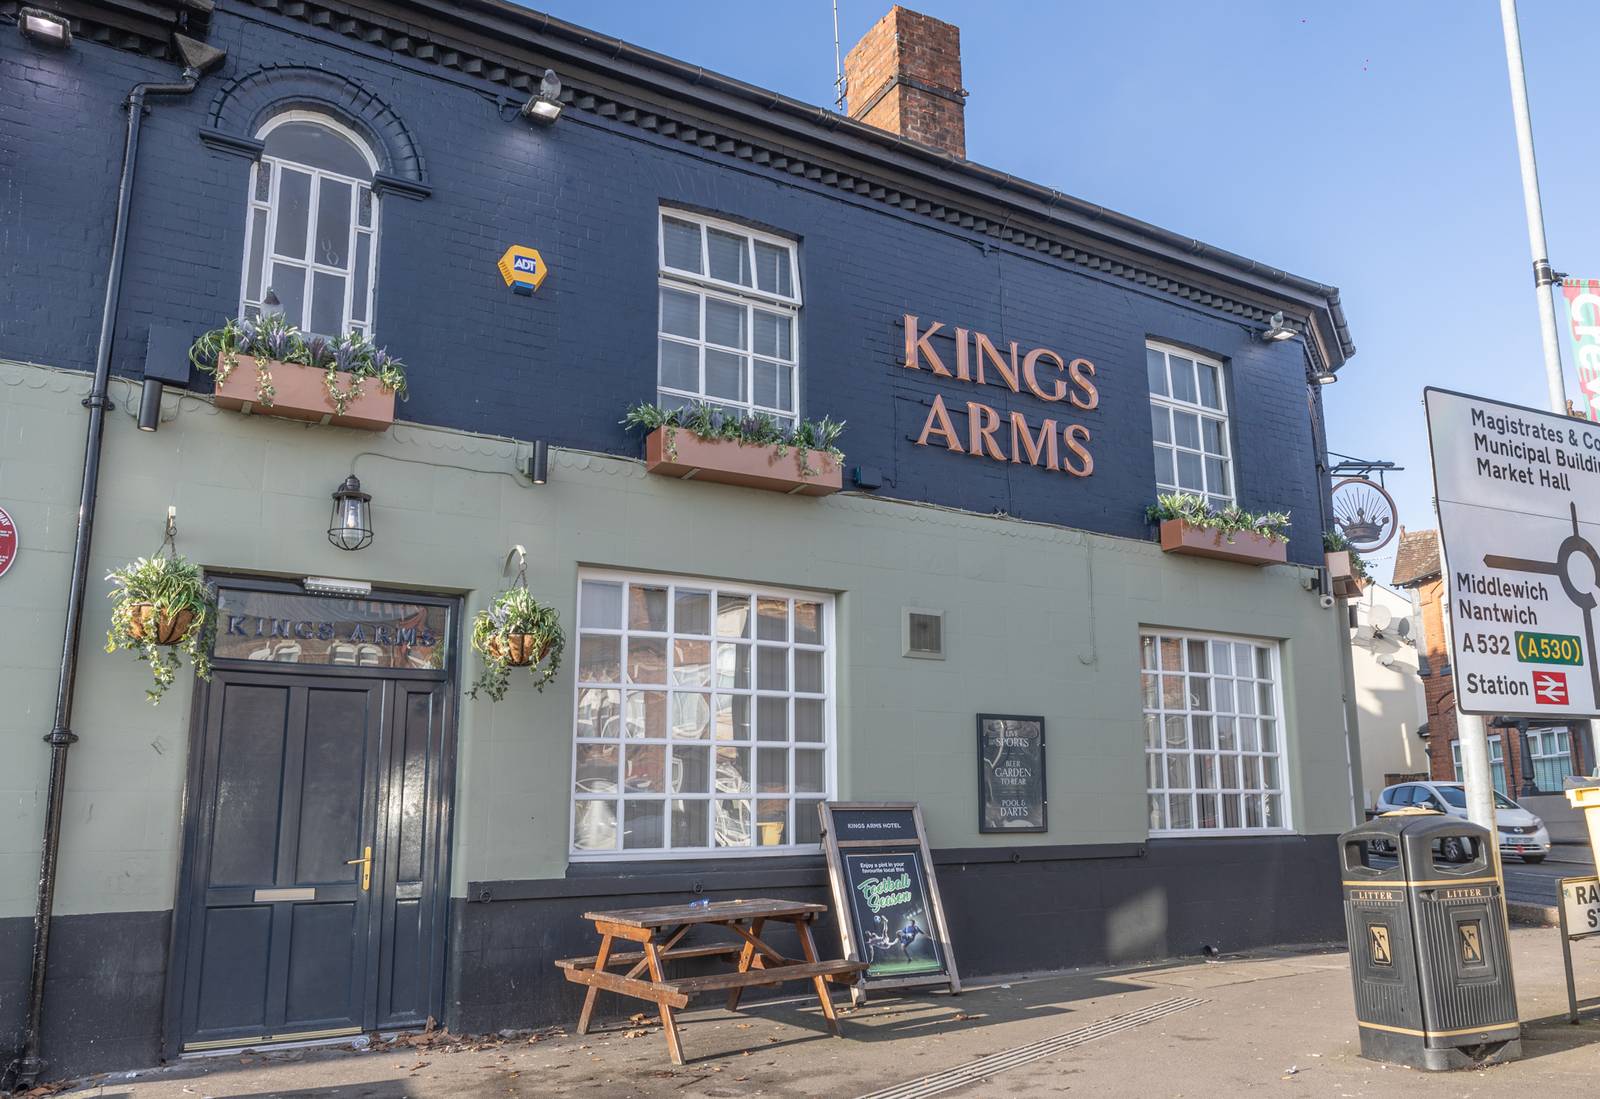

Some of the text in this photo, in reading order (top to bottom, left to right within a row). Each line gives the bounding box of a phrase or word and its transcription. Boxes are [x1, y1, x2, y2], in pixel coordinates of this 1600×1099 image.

[514, 258, 536, 272] ADT
[903, 313, 1099, 410] KINGS
[915, 393, 1094, 478] ARMS
[1471, 407, 1563, 443] Magistrates
[1568, 429, 1578, 447] &
[1474, 432, 1551, 465] Municipal
[1477, 457, 1571, 491] Market Hall
[1457, 572, 1548, 601] Middlewich
[1459, 599, 1538, 625] Nantwich
[225, 615, 436, 647] KINGS ARMS
[1467, 673, 1529, 696] Station
[995, 737, 1029, 747] SPORTS
[995, 767, 1032, 777] GARDEN
[1001, 807, 1029, 817] DARTS
[857, 873, 911, 900] Football
[1359, 891, 1393, 900] LITTER
[1447, 888, 1482, 899] LITTER
[1576, 884, 1600, 905] RA
[867, 891, 912, 914] Season
